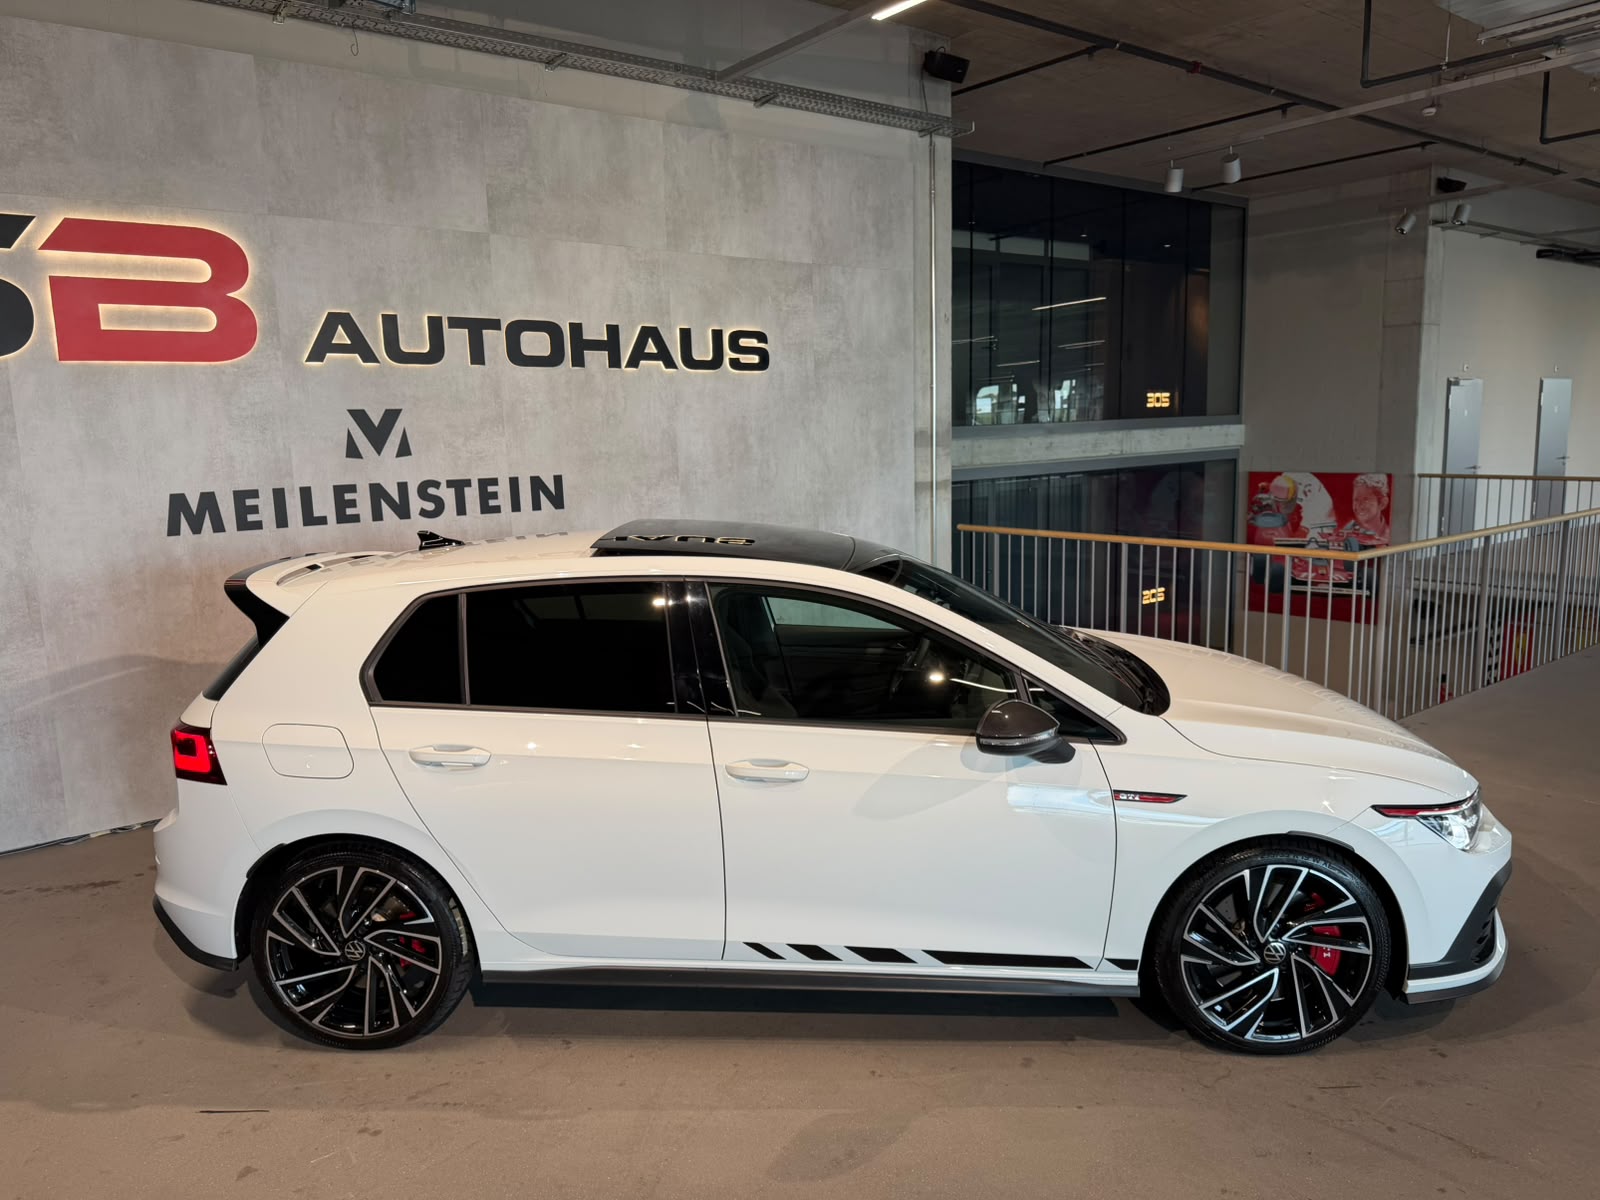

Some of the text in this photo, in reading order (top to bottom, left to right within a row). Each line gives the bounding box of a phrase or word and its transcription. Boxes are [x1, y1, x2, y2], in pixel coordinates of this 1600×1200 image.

[0, 213, 258, 363] B
[304, 311, 770, 372] AUTOHAUS
[1146, 392, 1171, 408] 305
[166, 474, 565, 537] MEILENSTEIN
[1119, 792, 1140, 801] GTI
